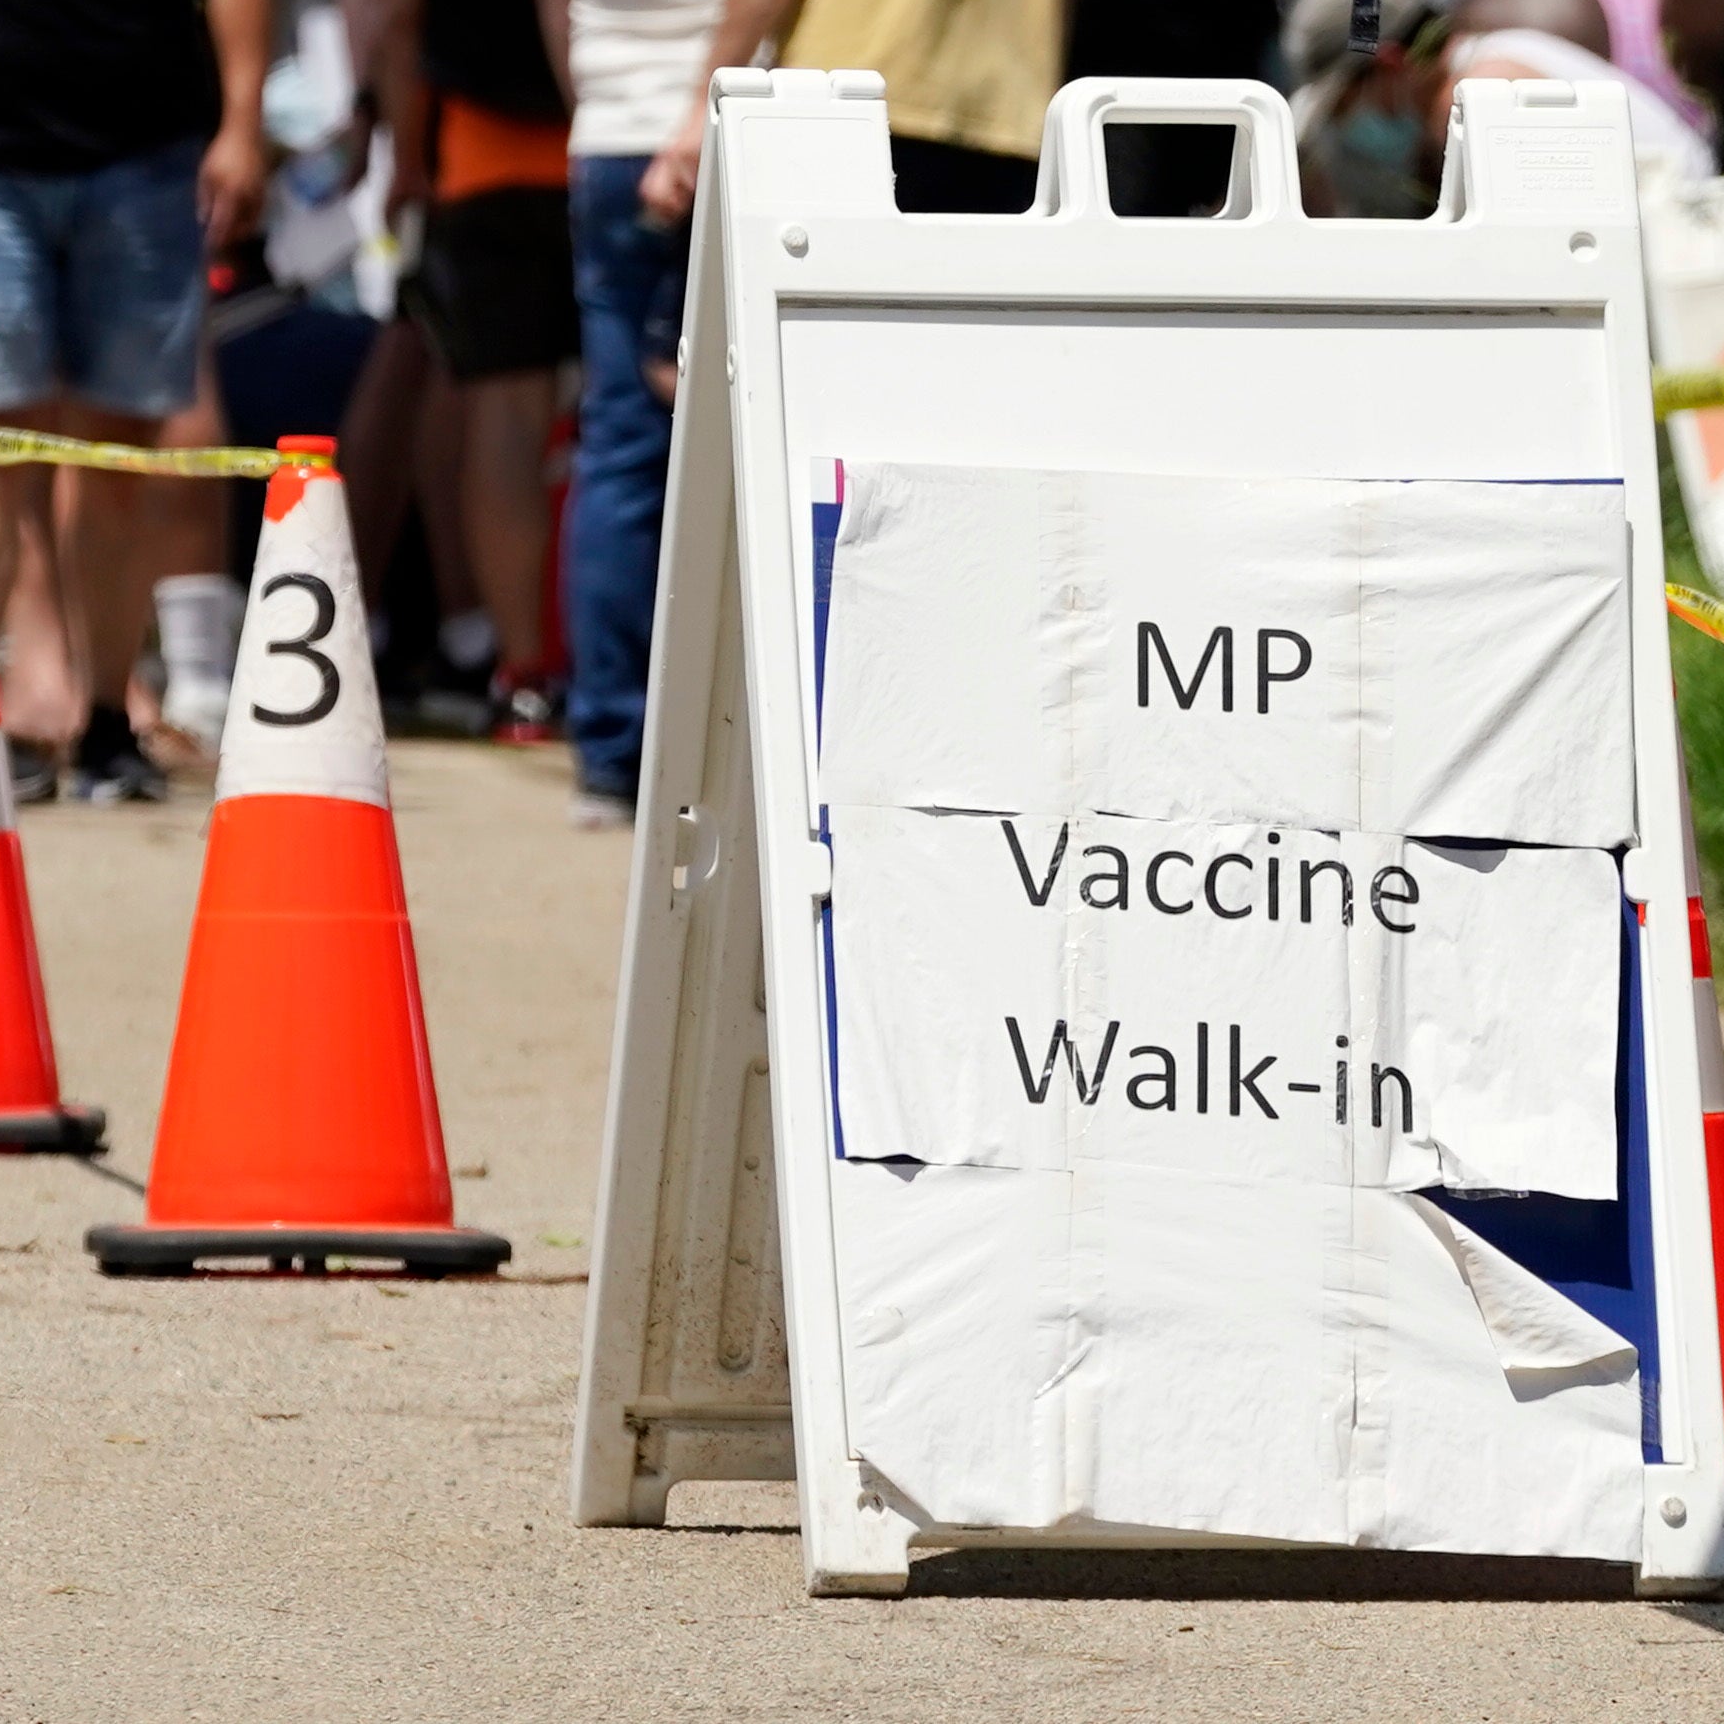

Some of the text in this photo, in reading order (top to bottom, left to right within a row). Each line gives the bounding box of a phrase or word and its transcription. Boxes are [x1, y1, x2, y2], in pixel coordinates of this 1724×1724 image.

[249, 572, 342, 727] 3
[1136, 620, 1314, 716] MP
[999, 819, 1422, 935] Vaccine
[1003, 1015, 1415, 1134] Walk-in
